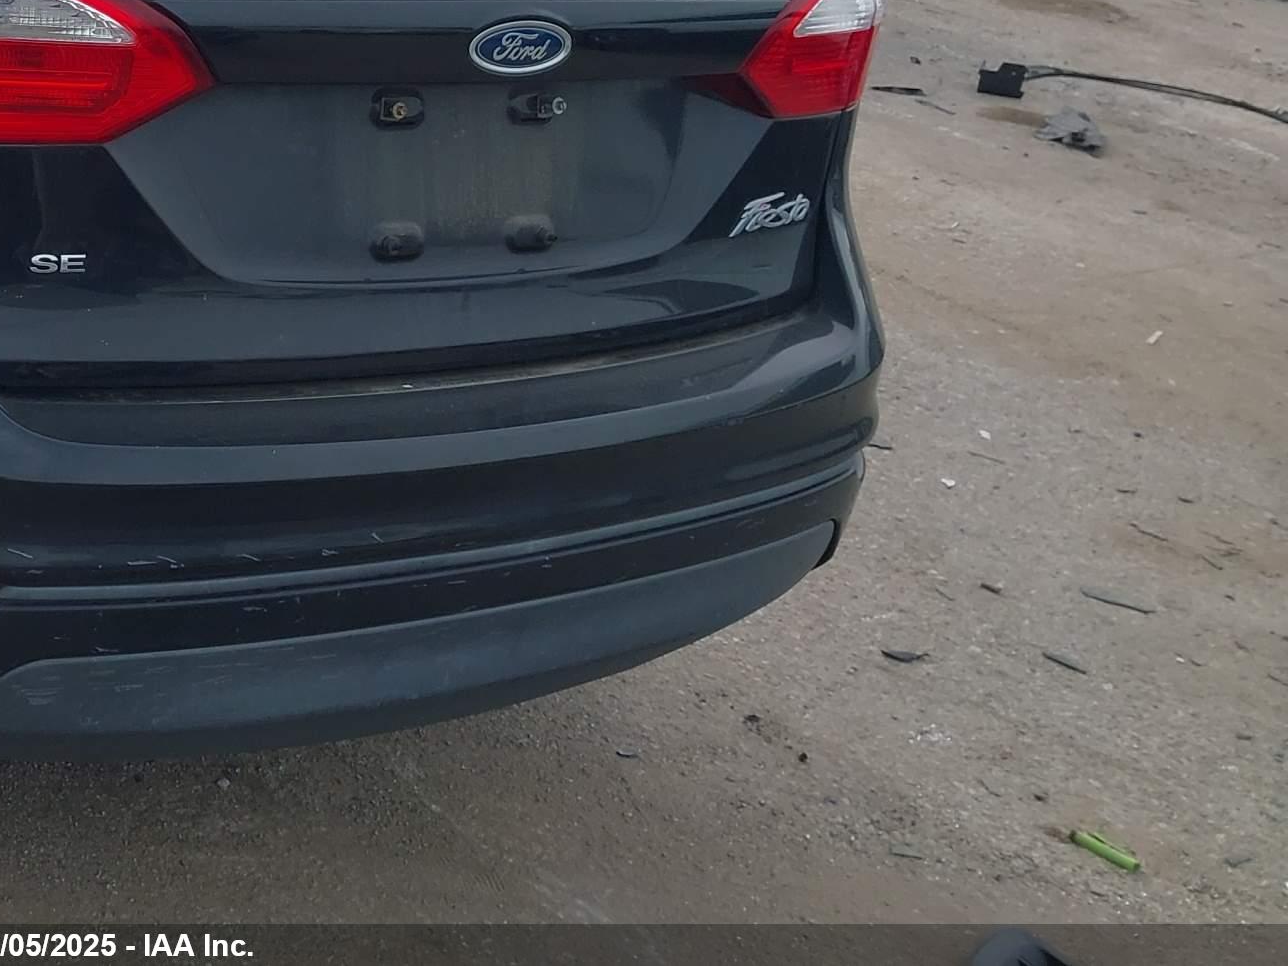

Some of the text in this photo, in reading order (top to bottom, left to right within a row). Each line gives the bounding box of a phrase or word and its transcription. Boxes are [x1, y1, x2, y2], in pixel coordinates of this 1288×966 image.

[493, 32, 551, 61] Ford
[728, 191, 810, 238] Fiesta
[29, 253, 86, 274] SE
